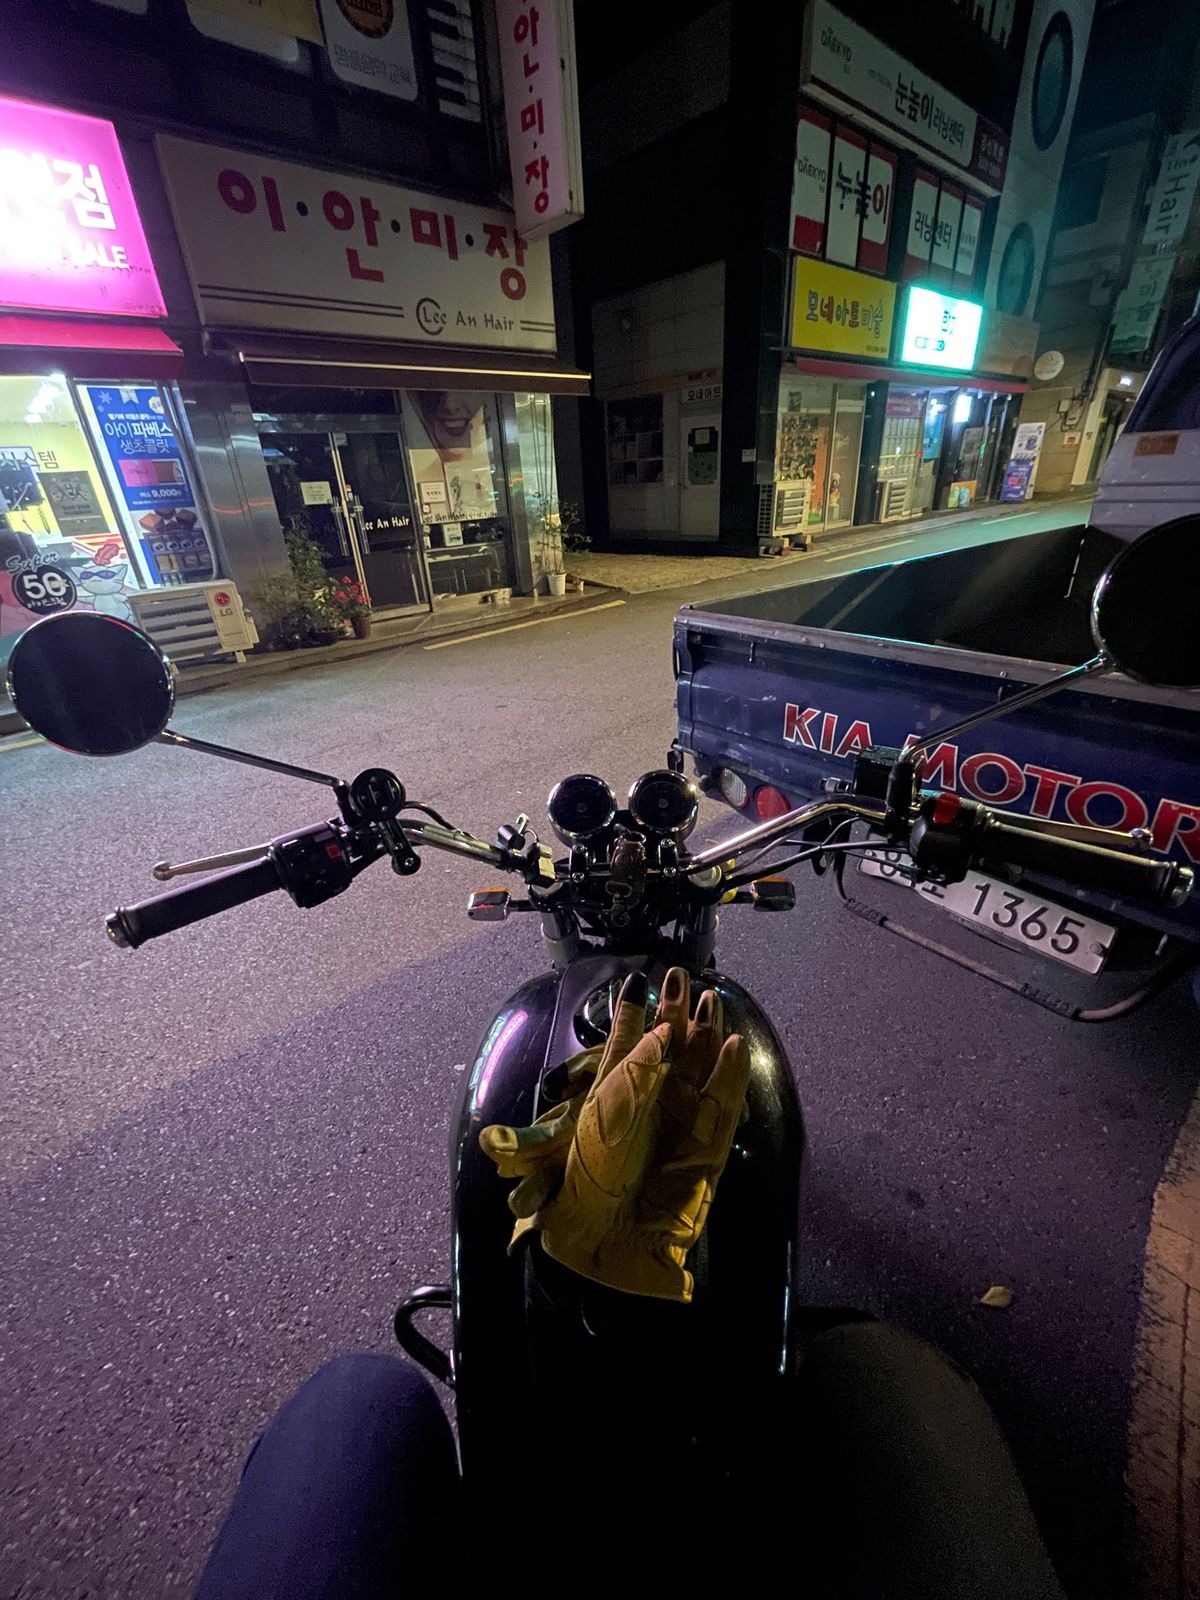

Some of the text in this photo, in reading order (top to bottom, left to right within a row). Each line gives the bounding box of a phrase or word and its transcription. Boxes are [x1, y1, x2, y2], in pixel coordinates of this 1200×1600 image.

[820, 30, 852, 62] DAEKYO
[895, 72, 935, 128] 눈높이
[934, 107, 965, 149] 러닝센터
[798, 158, 827, 183] DAEKYO
[1154, 173, 1190, 235] Hair
[456, 309, 478, 326] An
[484, 313, 515, 331] Hair
[376, 517, 390, 529] An
[391, 515, 410, 528] Hair
[5, 551, 60, 576] Super
[22, 572, 67, 600] 50
[220, 607, 234, 617] LG
[782, 702, 873, 759] KIA
[973, 883, 1085, 954] 1365
